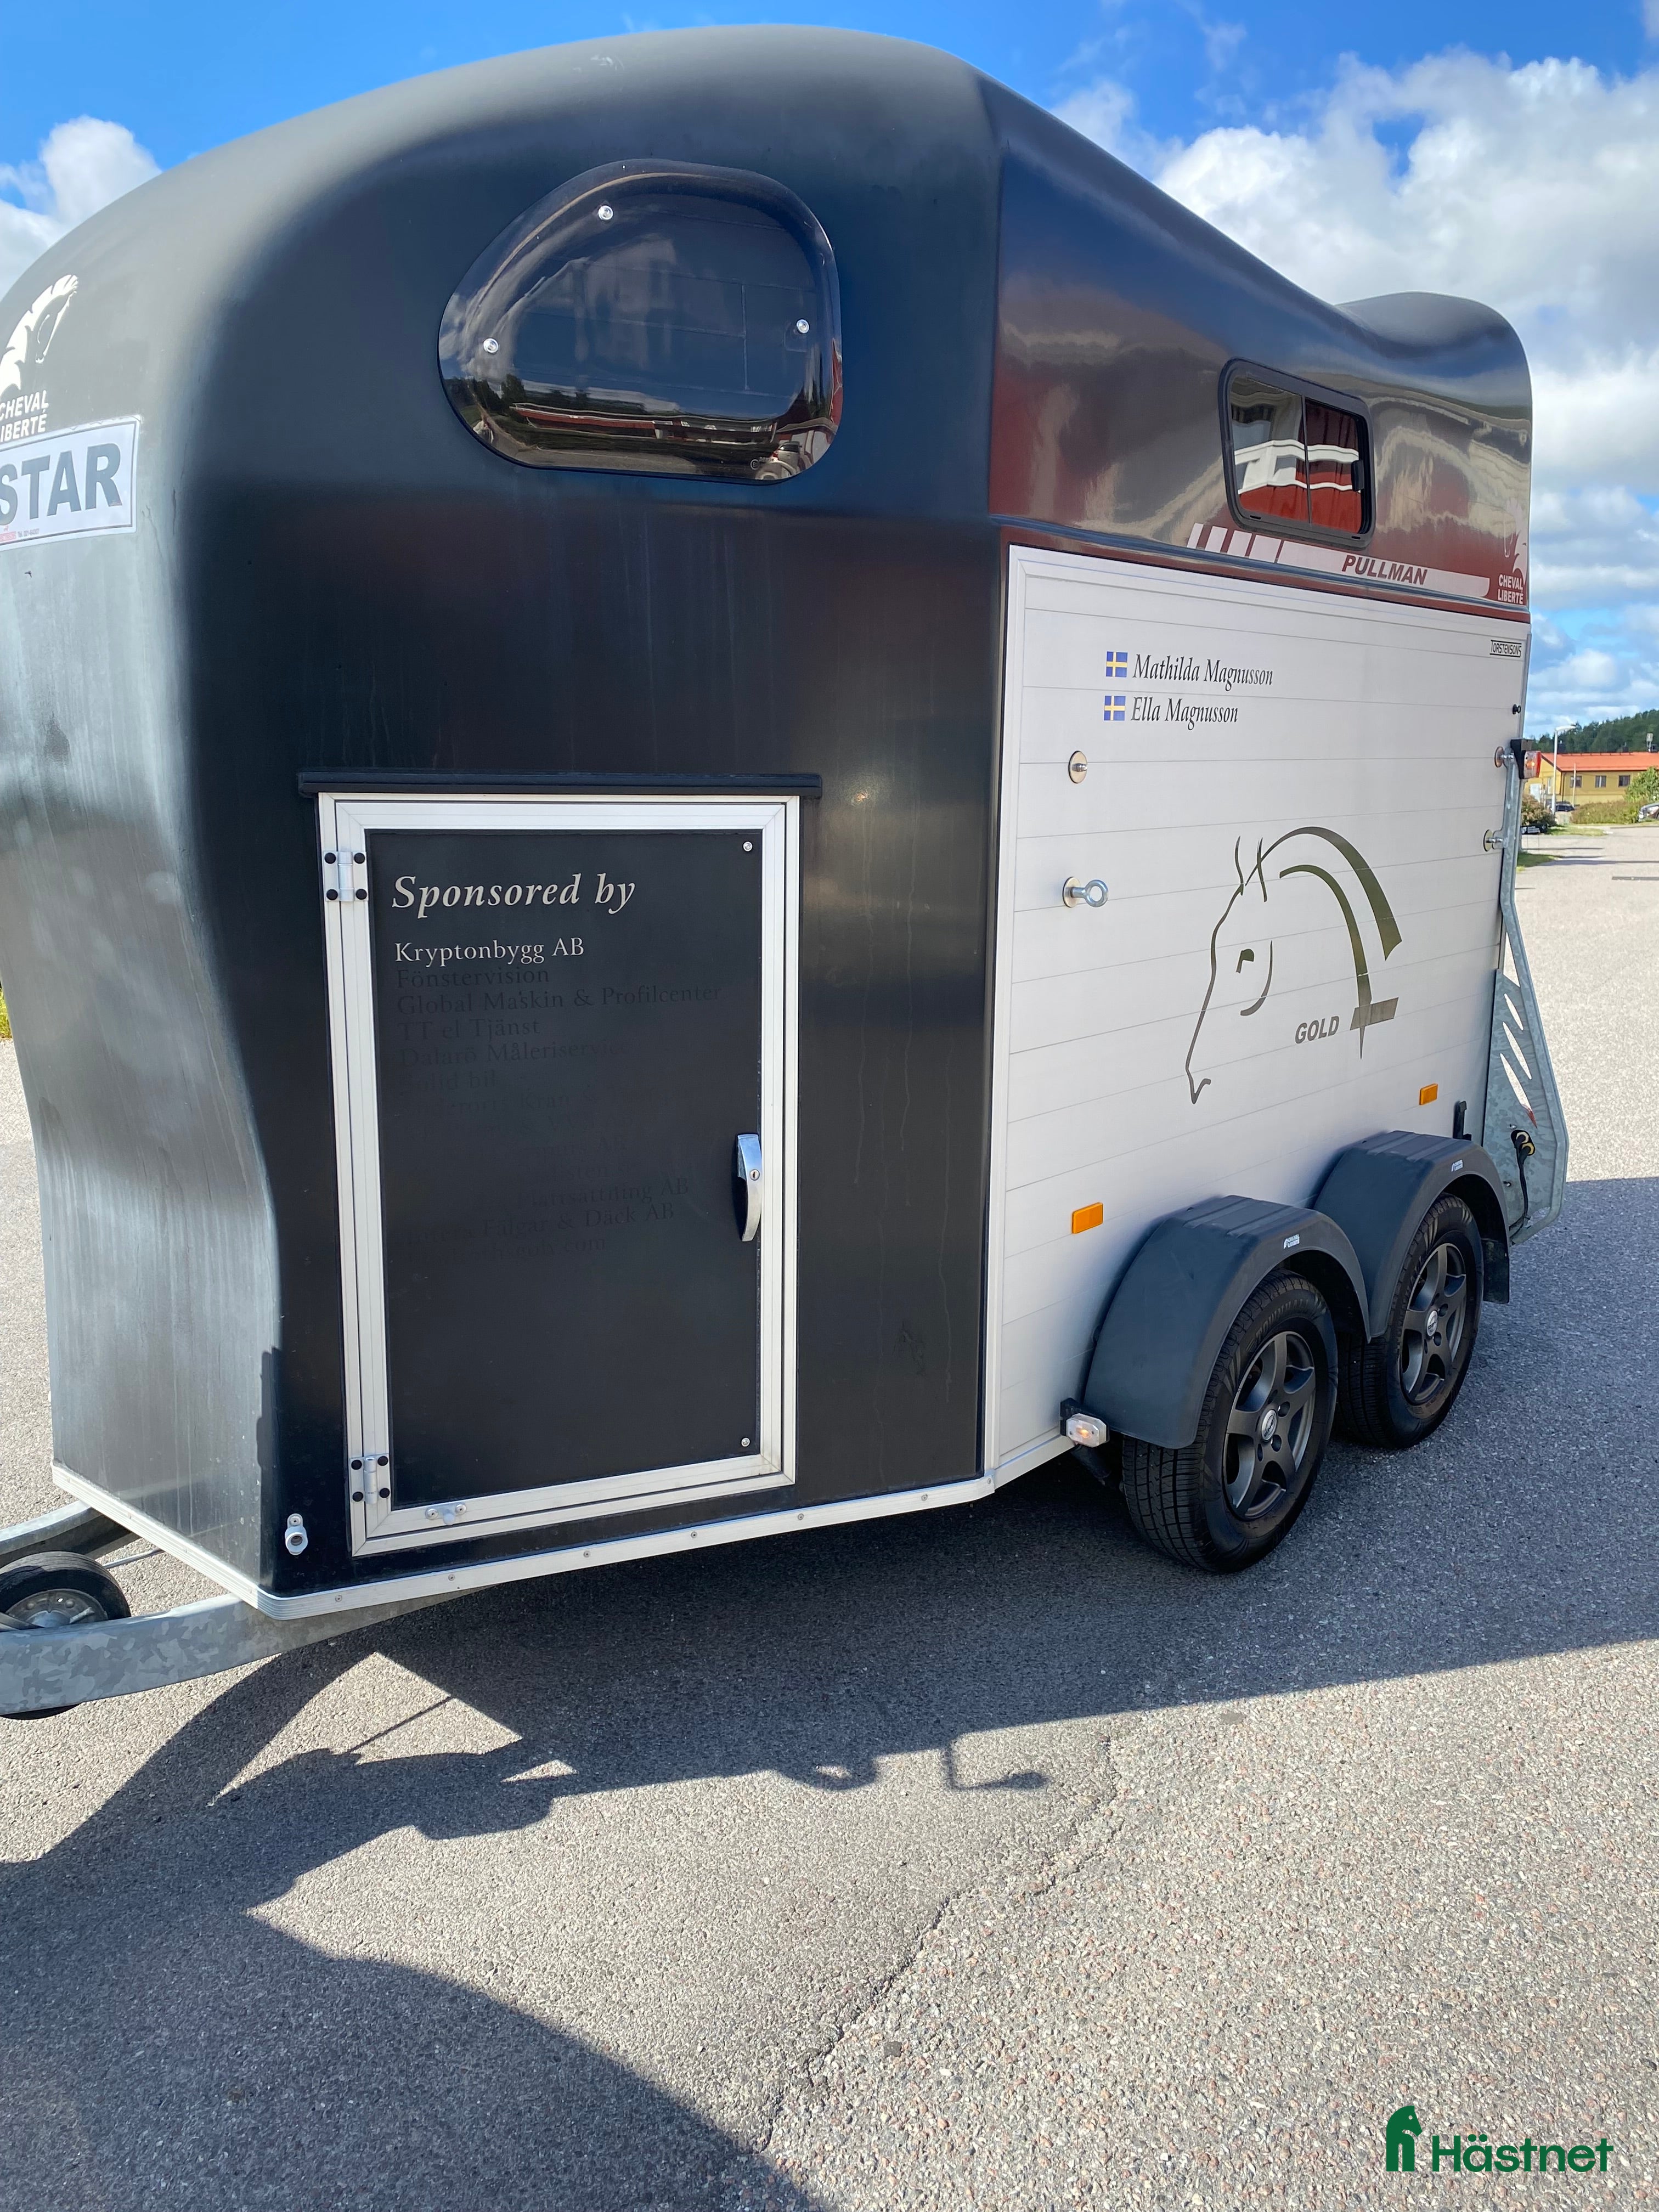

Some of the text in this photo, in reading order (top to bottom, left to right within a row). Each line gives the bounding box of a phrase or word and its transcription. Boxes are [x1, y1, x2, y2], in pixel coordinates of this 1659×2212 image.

[0, 390, 49, 422] CHEVAL
[0, 409, 47, 442] IBERTÉ
[0, 443, 122, 526] STAR
[1341, 555, 1427, 585] PULLMAN
[1498, 574, 1523, 590] CHEVAL
[1498, 589, 1523, 605] LIBERTÉ
[1490, 641, 1522, 657] TORSTENSONS
[1132, 653, 1273, 692] Mathilda Magnusson
[1131, 696, 1238, 731] Ella Magnusson
[392, 873, 635, 919] Sponsored by
[395, 937, 584, 968] Kryptonbygg AB
[397, 967, 549, 988] Fönstervision
[397, 985, 721, 1014] Global Maskin & Profilcenter
[1295, 1015, 1340, 1044] GOLD
